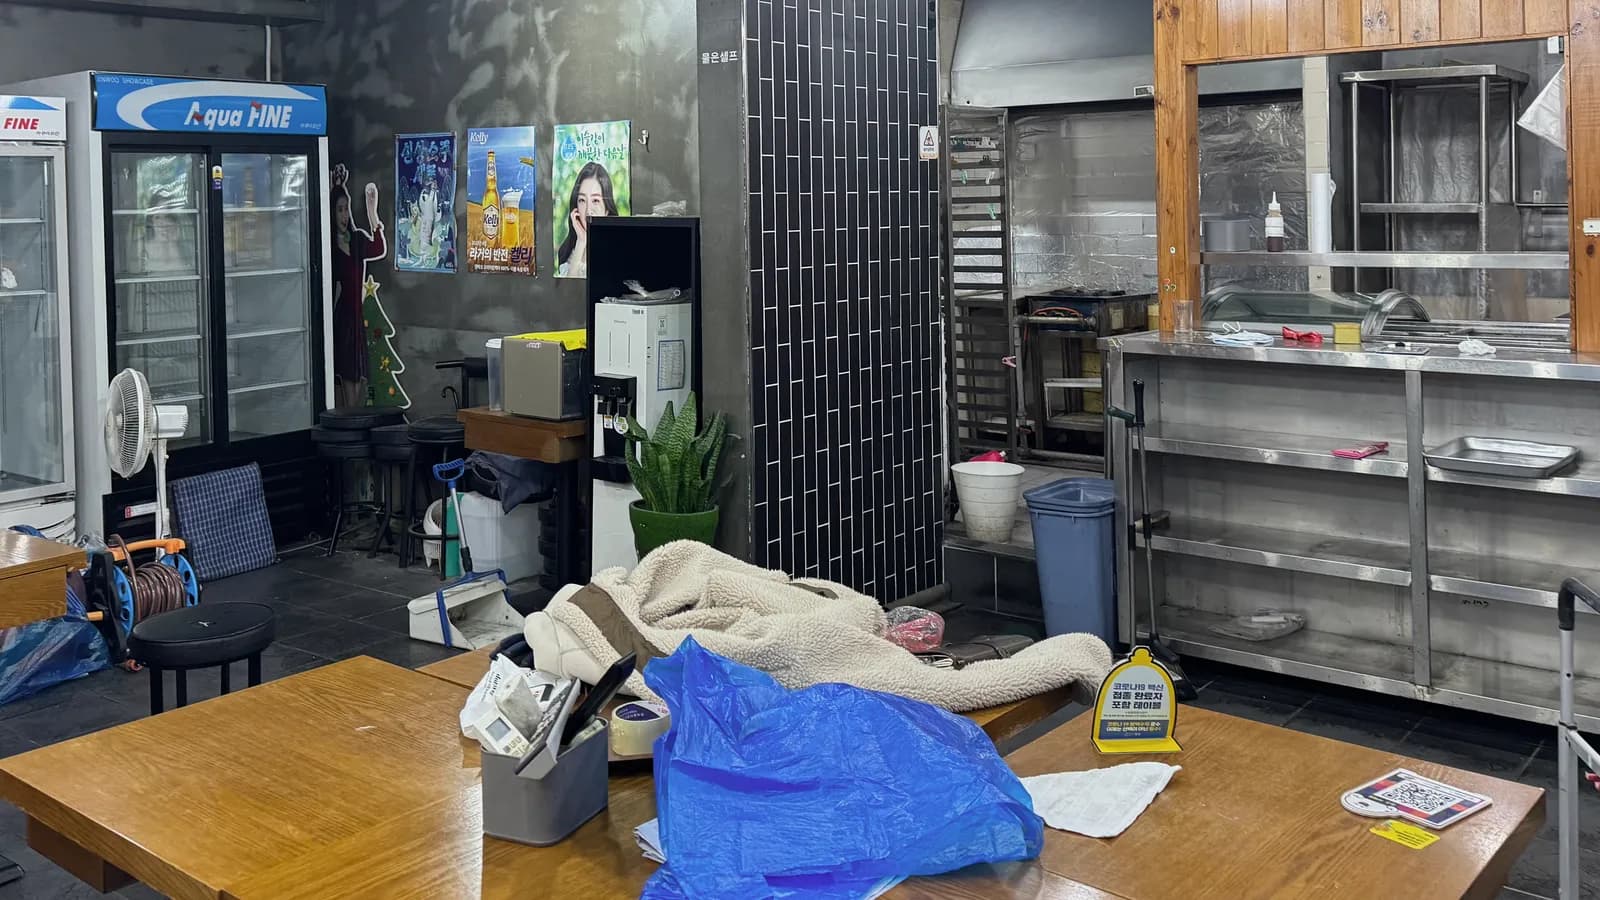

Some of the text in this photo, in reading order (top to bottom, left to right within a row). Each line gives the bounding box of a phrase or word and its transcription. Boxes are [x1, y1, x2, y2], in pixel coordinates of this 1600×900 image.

[702, 50, 738, 65] 물은셀프
[3, 117, 40, 130] FINE
[184, 101, 293, 131] Aqua FINE
[470, 130, 489, 145] Kelly
[577, 146, 602, 162] 깨끗한
[483, 213, 499, 228] Kelly
[469, 246, 492, 261] 라거의
[493, 247, 508, 262] 반전
